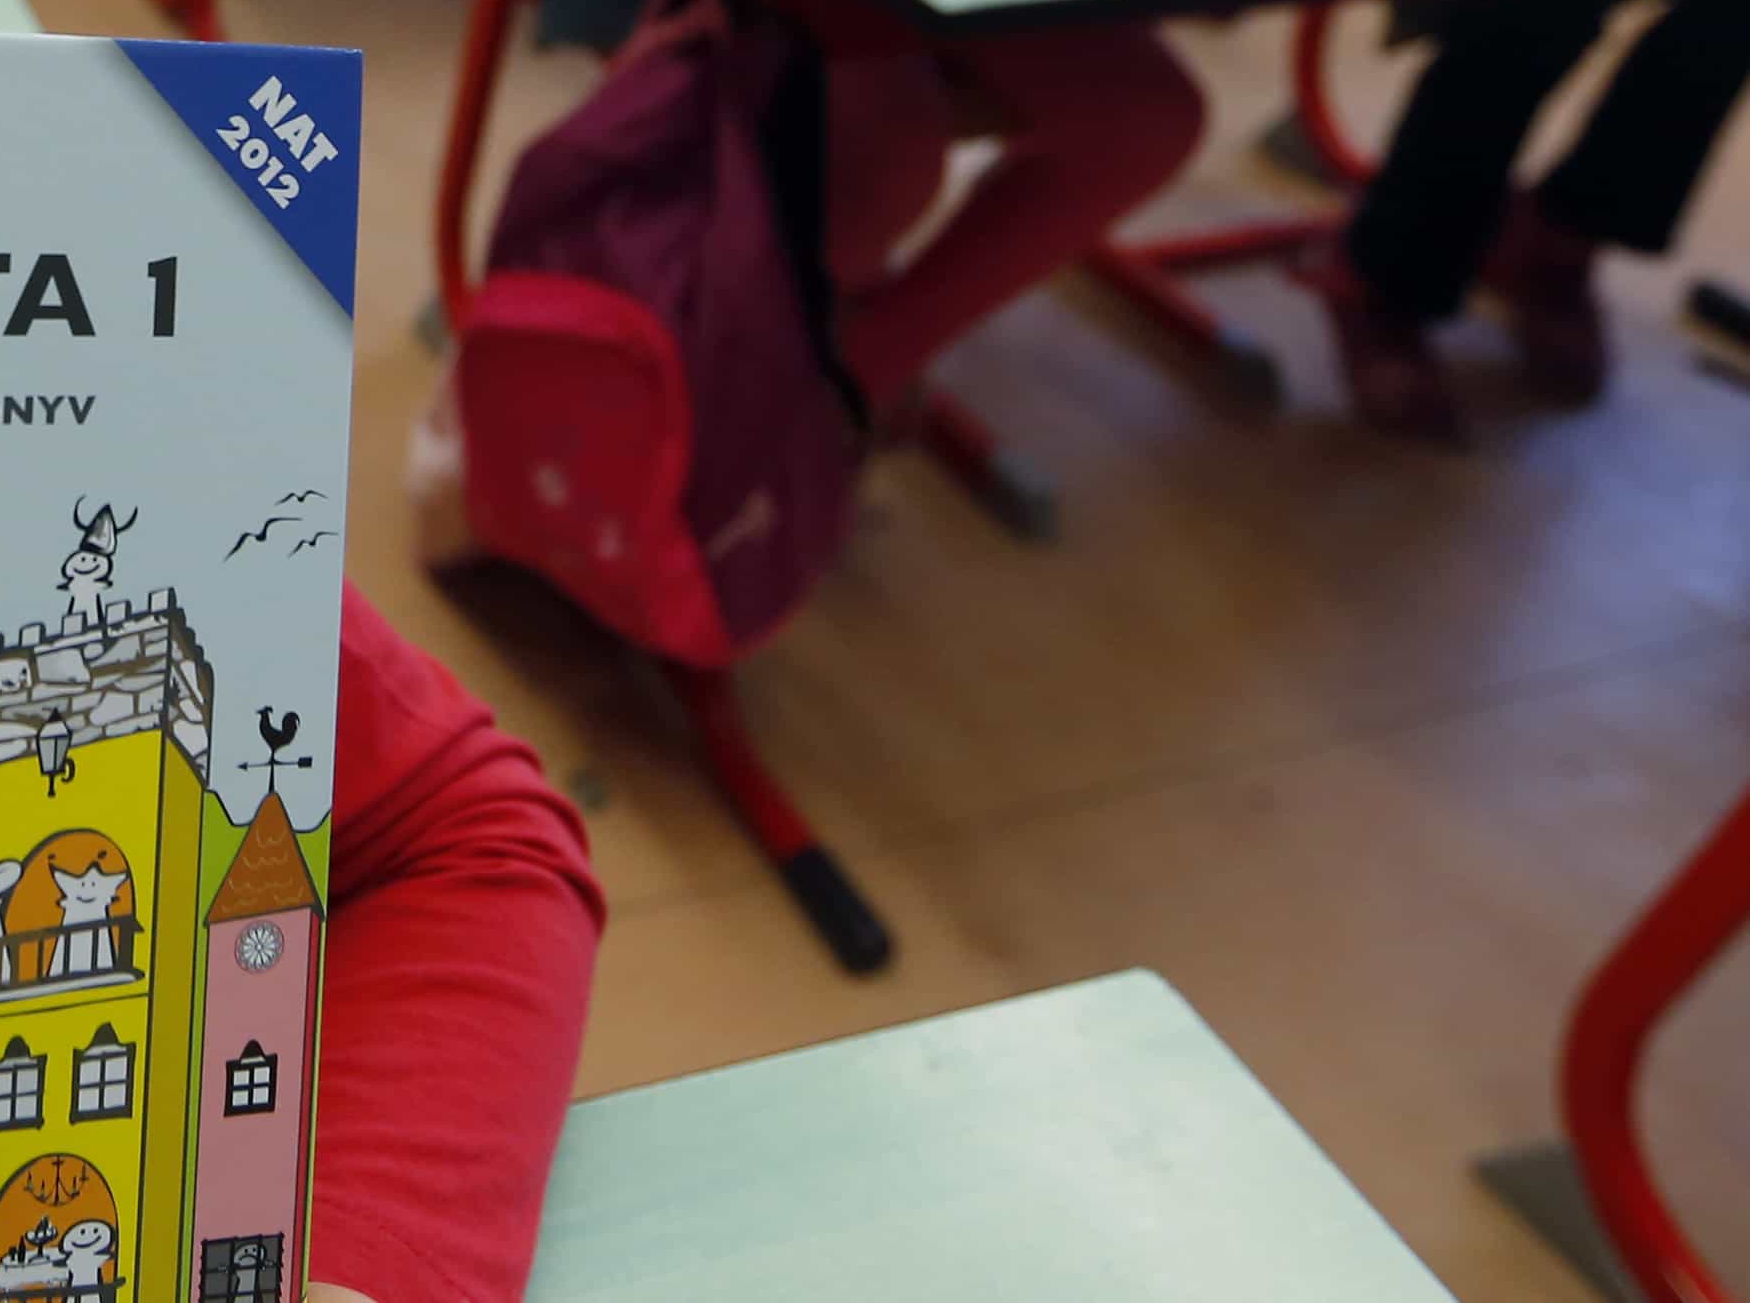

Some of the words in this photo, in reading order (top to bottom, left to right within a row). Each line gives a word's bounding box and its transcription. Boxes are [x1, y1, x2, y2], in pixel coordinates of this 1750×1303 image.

[216, 115, 300, 209] 2012
[249, 75, 339, 172] NAT
[146, 255, 179, 339] 1
